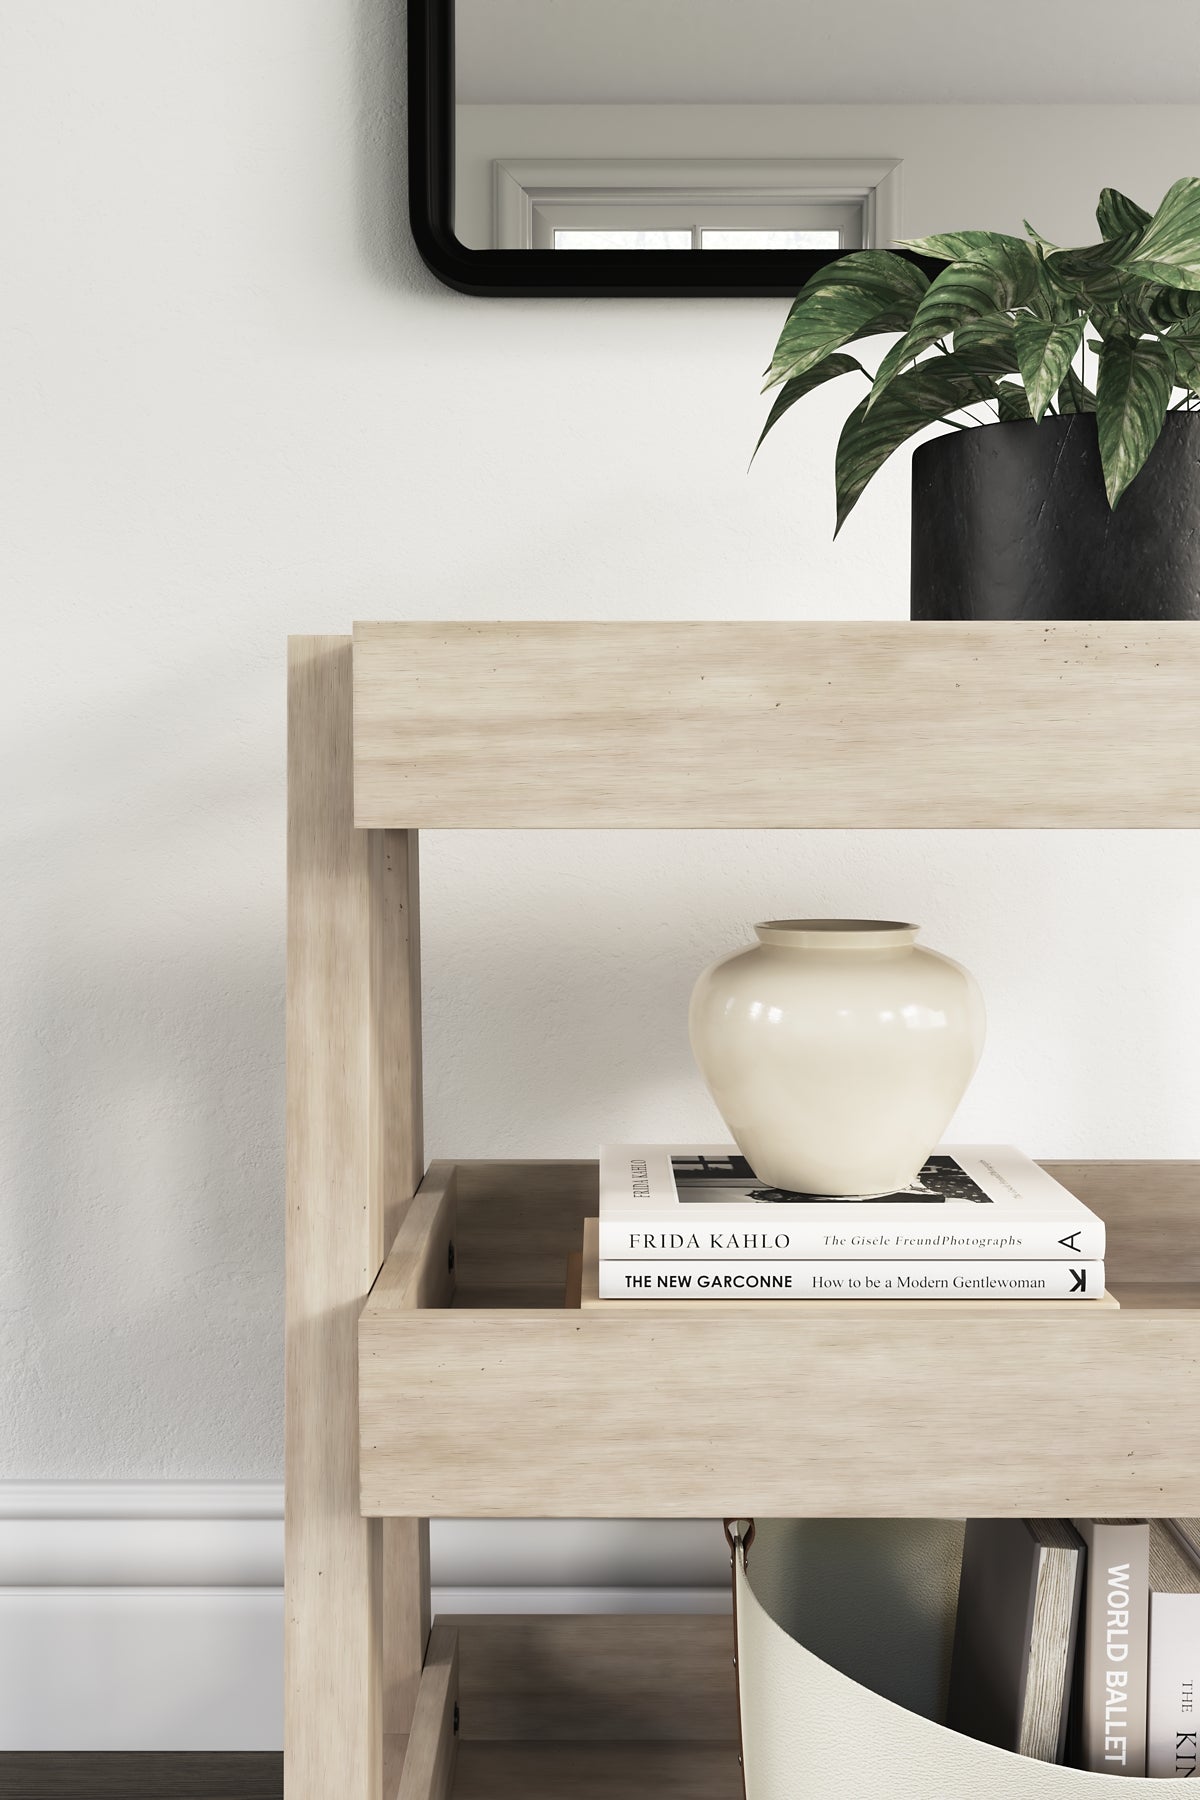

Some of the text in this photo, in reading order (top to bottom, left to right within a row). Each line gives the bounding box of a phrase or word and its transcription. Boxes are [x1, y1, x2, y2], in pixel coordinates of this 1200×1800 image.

[630, 1159, 650, 1198] FRIDA KAHLO
[629, 1233, 790, 1249] FRIDA KAHLO
[824, 1235, 846, 1246] The
[625, 1275, 792, 1288] THE NEW GARCONNE
[812, 1276, 1046, 1288] How to be a Modern Gentlewoman
[1104, 1563, 1130, 1766] WORLD BALLET
[1182, 1680, 1193, 1712] THE
